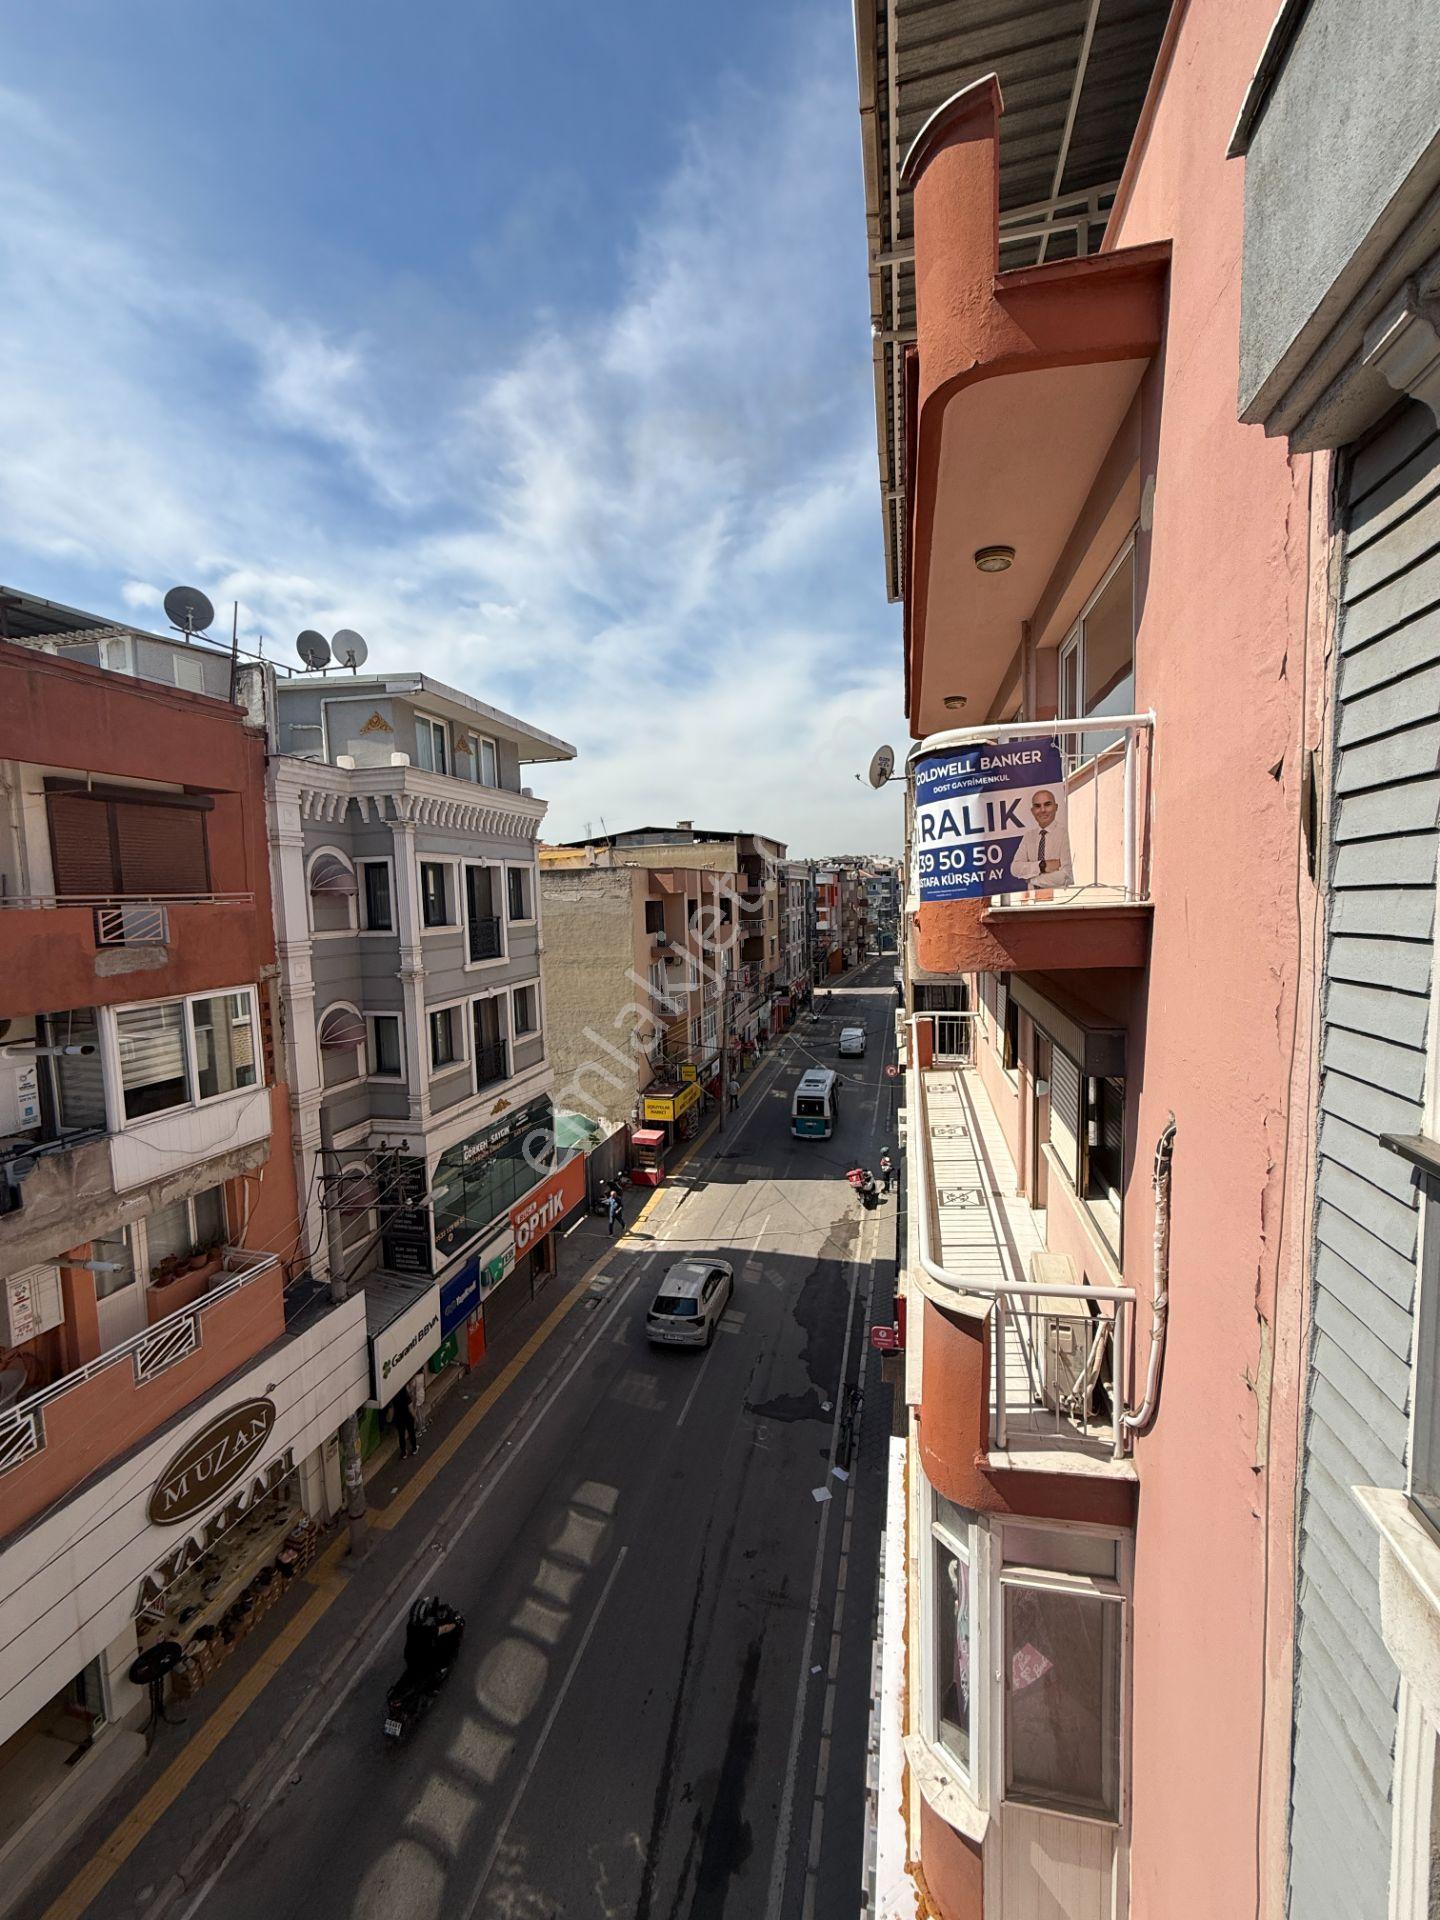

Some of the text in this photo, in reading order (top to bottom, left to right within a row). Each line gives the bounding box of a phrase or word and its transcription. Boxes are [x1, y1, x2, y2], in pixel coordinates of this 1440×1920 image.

[916, 760, 976, 786] COLDWELL
[980, 750, 1042, 770] BANKER
[933, 774, 1010, 794] DOST GAYRİMENKUL
[918, 798, 1026, 844] RALIK
[939, 849, 965, 870] 50
[972, 844, 1003, 865] 50
[941, 870, 986, 886] KÜRŞAT
[988, 868, 1004, 880] AY
[516, 1189, 564, 1248] OPTİK
[391, 1334, 418, 1368] Garanti
[418, 1315, 439, 1342] BBVA
[163, 1409, 268, 1512] MUZAN
